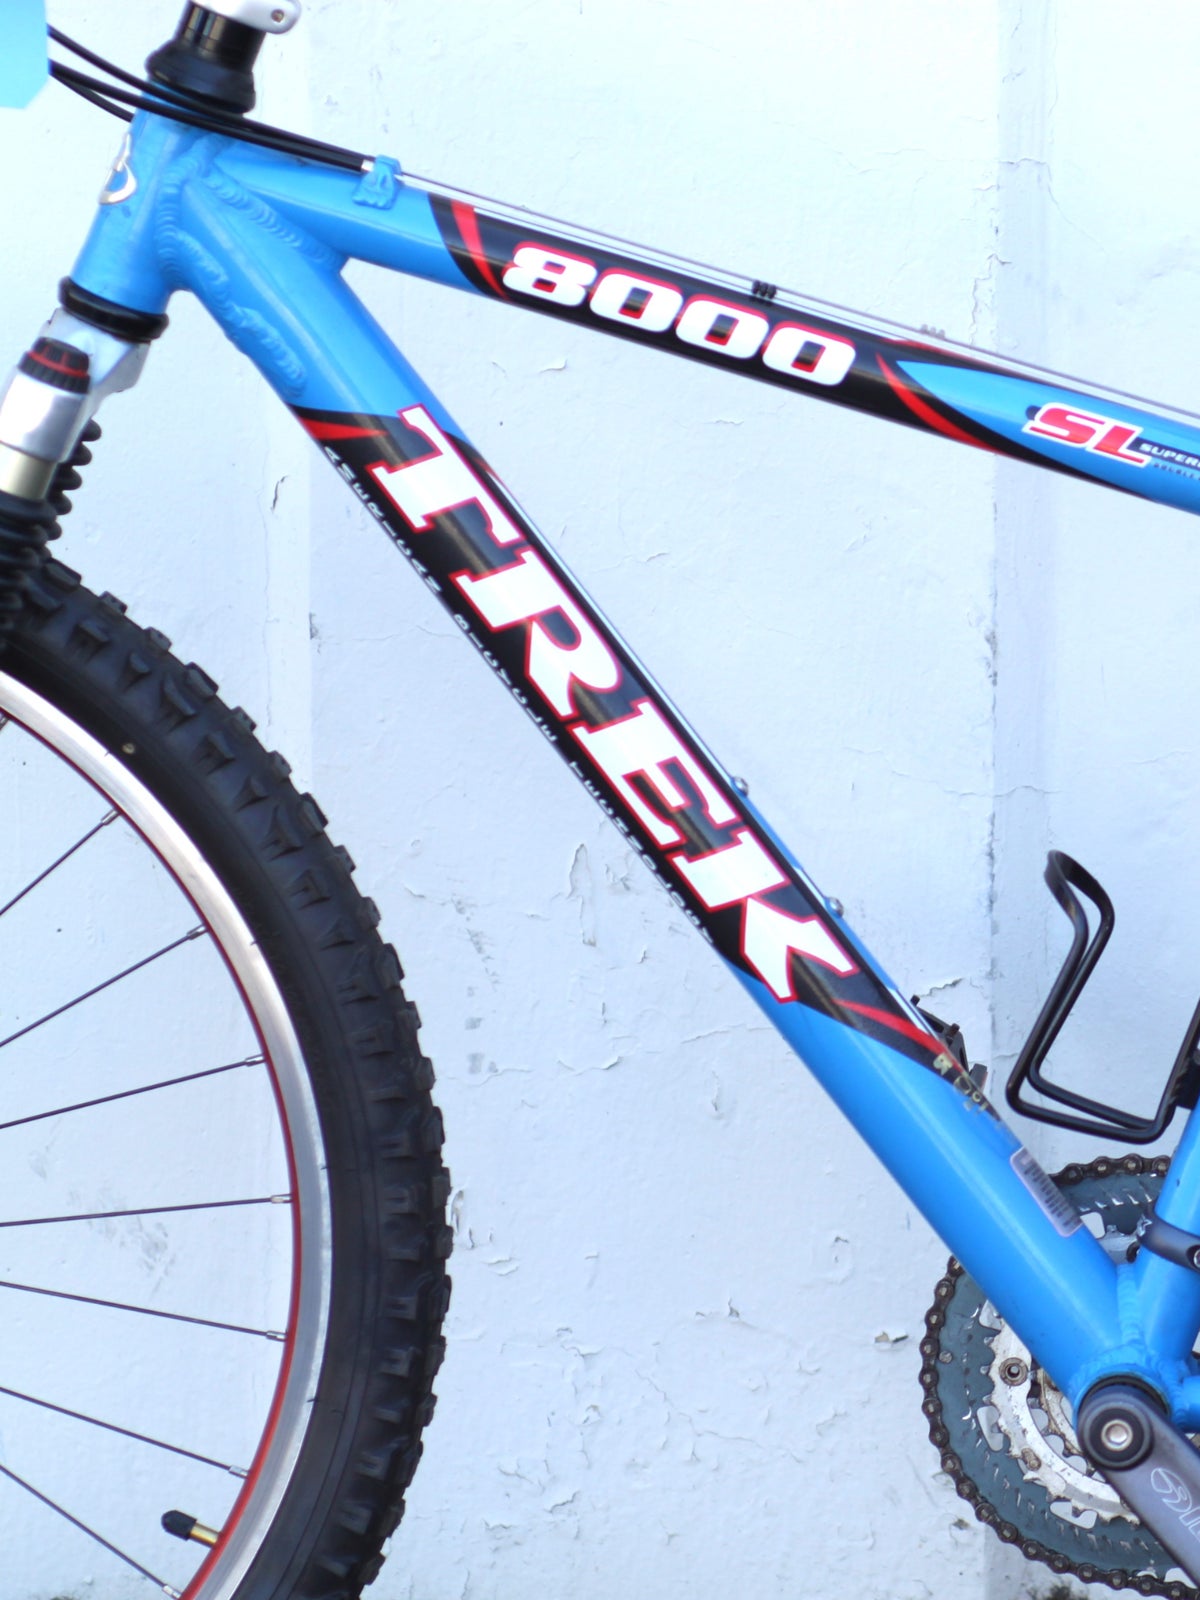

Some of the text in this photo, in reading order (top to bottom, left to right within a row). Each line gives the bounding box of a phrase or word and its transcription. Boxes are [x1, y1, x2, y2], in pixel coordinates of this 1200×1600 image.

[502, 241, 856, 386] 8000
[1022, 402, 1152, 468] SL
[323, 446, 443, 594] AMERICAN
[453, 613, 558, 742] BICYCLE
[366, 402, 862, 1004] TREK
